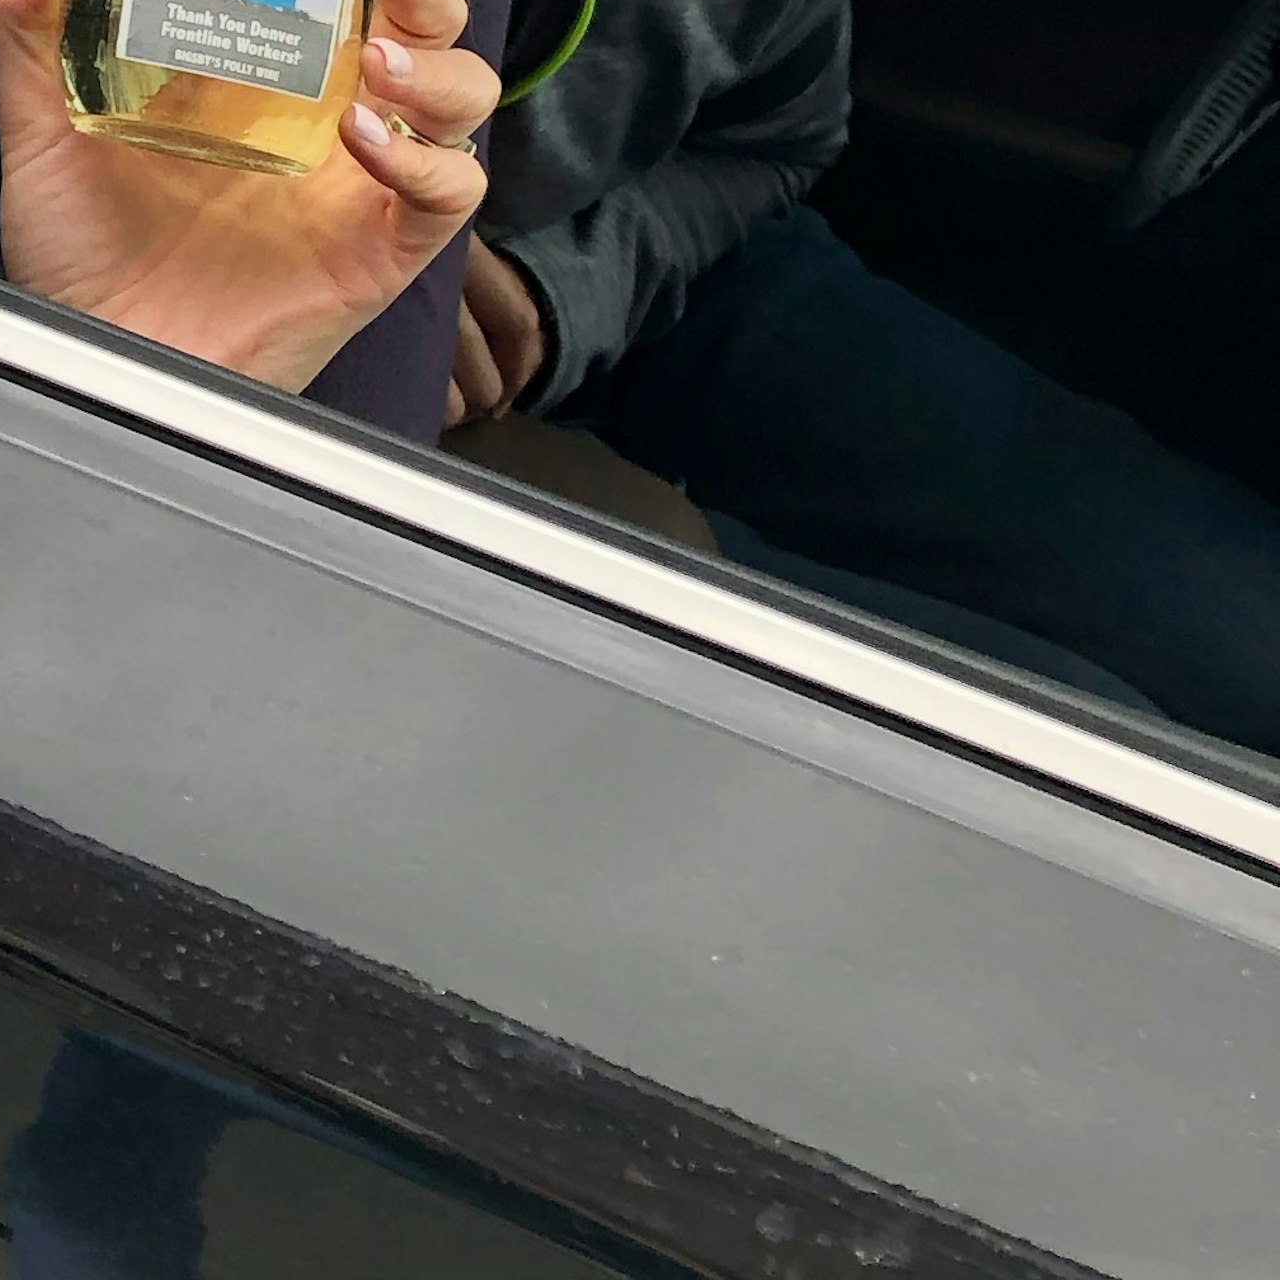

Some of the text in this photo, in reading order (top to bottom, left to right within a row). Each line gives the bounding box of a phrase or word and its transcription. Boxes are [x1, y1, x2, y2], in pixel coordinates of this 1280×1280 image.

[160, 21, 303, 67] Frontline Workers!
[167, 2, 302, 48] Thank You Denver
[223, 58, 255, 74] FOLLY
